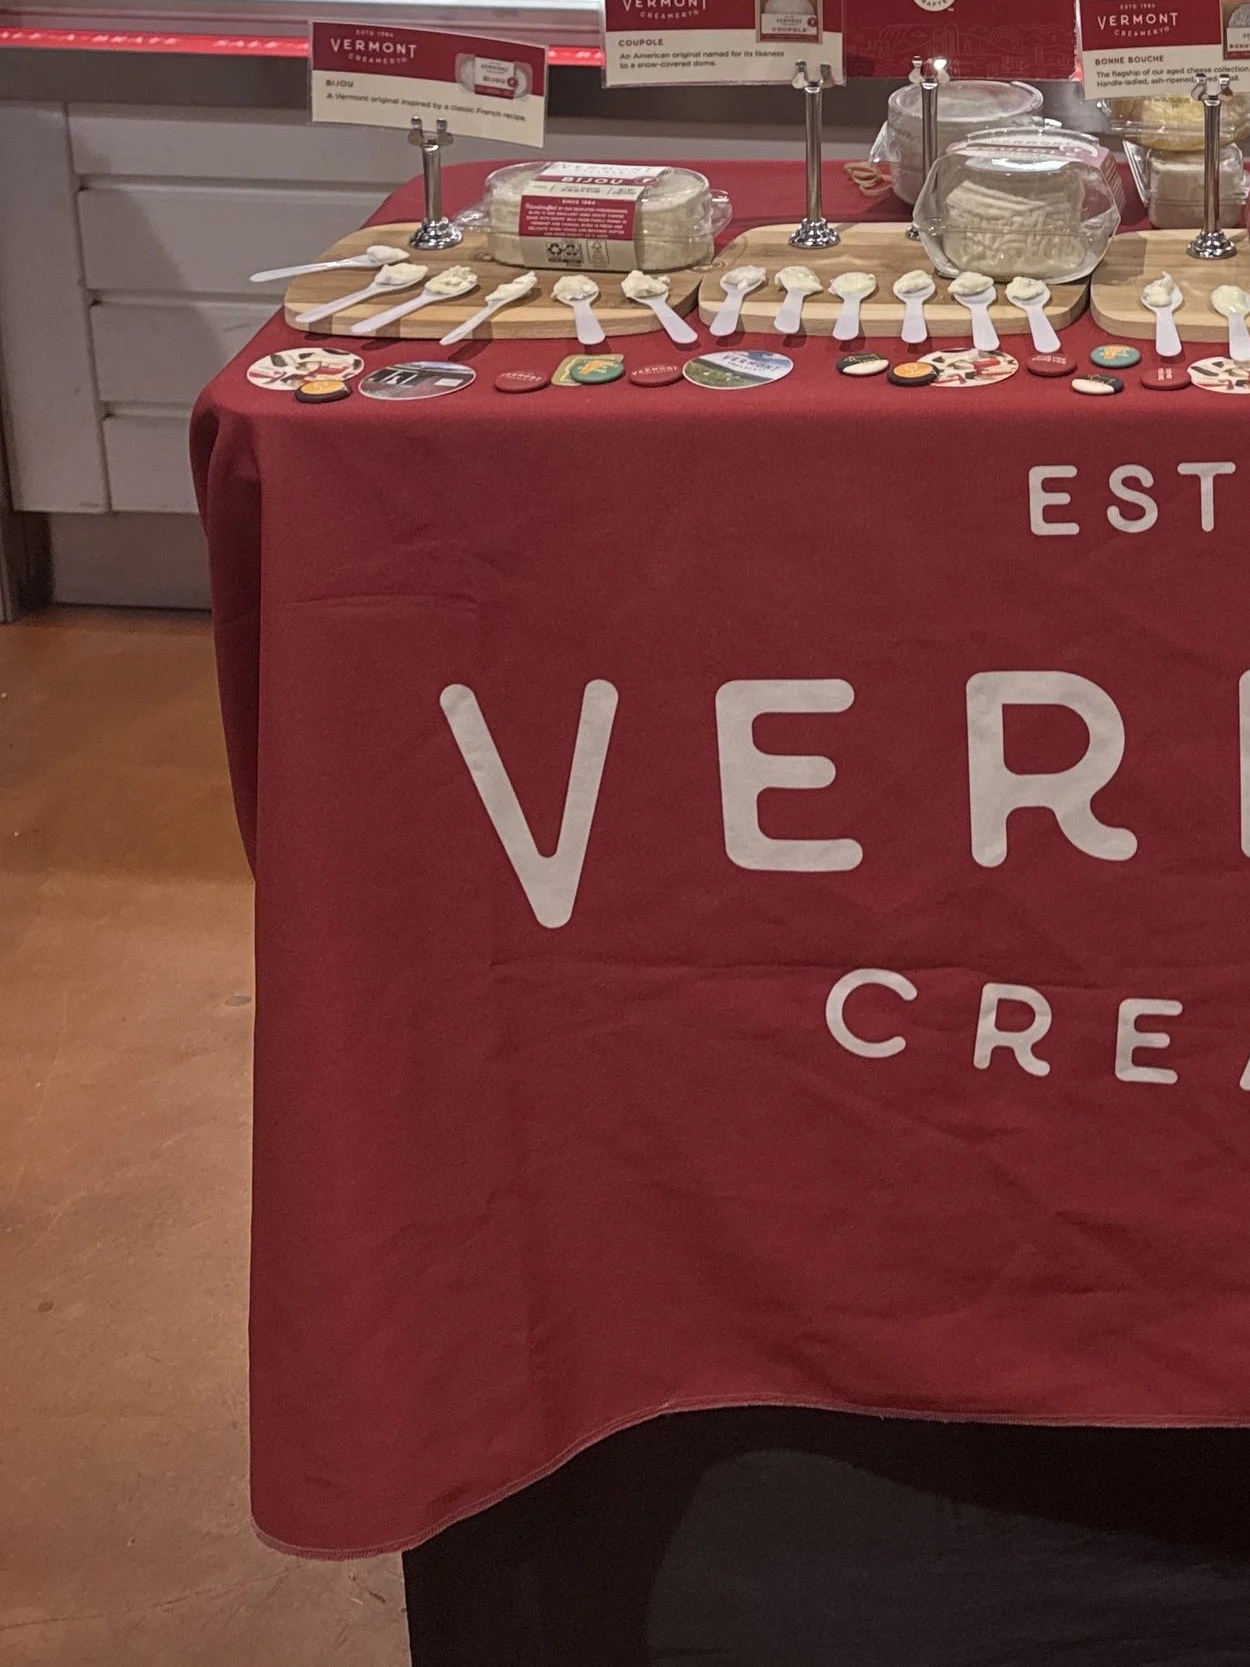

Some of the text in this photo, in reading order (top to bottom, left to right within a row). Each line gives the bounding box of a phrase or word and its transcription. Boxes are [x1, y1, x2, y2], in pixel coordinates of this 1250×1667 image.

[1097, 12, 1179, 31] VERMONT
[330, 37, 417, 59] VERMONT
[618, 38, 664, 47] COUPOLE
[633, 51, 671, 60] American
[672, 50, 701, 61] original
[702, 50, 729, 59] named
[730, 50, 742, 58] for
[743, 49, 753, 58] its
[754, 49, 785, 59] likeness
[1095, 54, 1164, 66] BONNE BOUCHE
[619, 62, 629, 70] to
[637, 60, 691, 70] snow-covered
[693, 59, 717, 69] dome.
[1096, 70, 1110, 79] The
[1111, 68, 1141, 80] flagship
[1142, 68, 1150, 76] of
[1166, 66, 1185, 77] aged
[1186, 66, 1212, 75] cheese
[1213, 64, 1250, 74] collection.
[325, 78, 354, 89] BIJOU
[335, 92, 369, 103] Vermont
[370, 94, 400, 106] original
[401, 97, 432, 111] inspired
[433, 101, 443, 111] by
[451, 102, 474, 114] classic
[476, 106, 501, 117] French
[503, 111, 527, 122] recipe.
[561, 177, 624, 185] BIJOU
[722, 354, 782, 373] VERMONT
